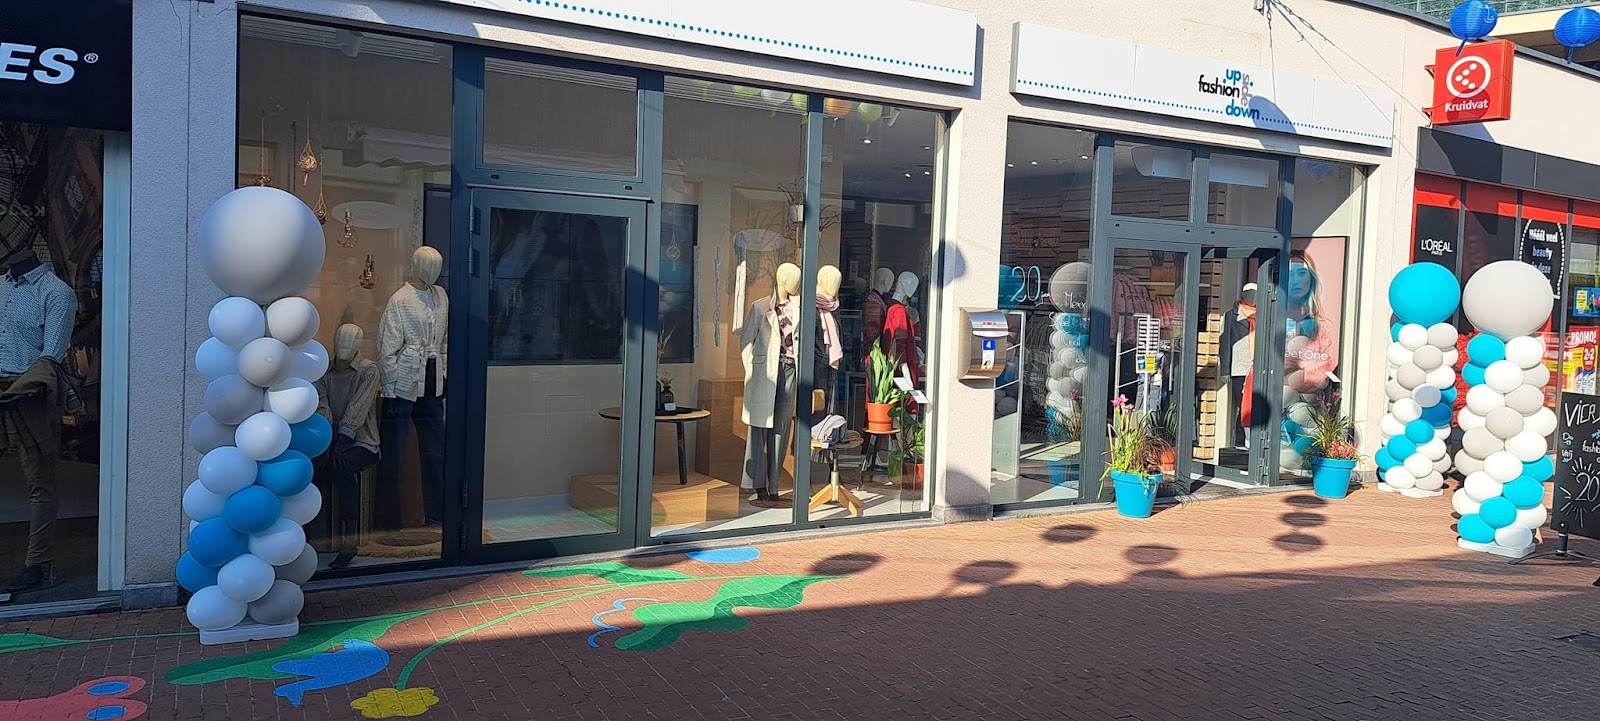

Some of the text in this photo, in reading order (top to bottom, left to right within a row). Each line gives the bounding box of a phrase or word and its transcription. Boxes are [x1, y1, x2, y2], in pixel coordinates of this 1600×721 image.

[1226, 69, 1241, 85] up
[1198, 74, 1240, 98] fashion
[1241, 73, 1253, 107] side
[1226, 99, 1260, 119] down
[1444, 99, 1489, 112] Kruidvat
[1532, 245, 1553, 260] beauty
[986, 340, 992, 349] 4
[1571, 330, 1597, 345] PROMO!
[1304, 350, 1328, 360] One
